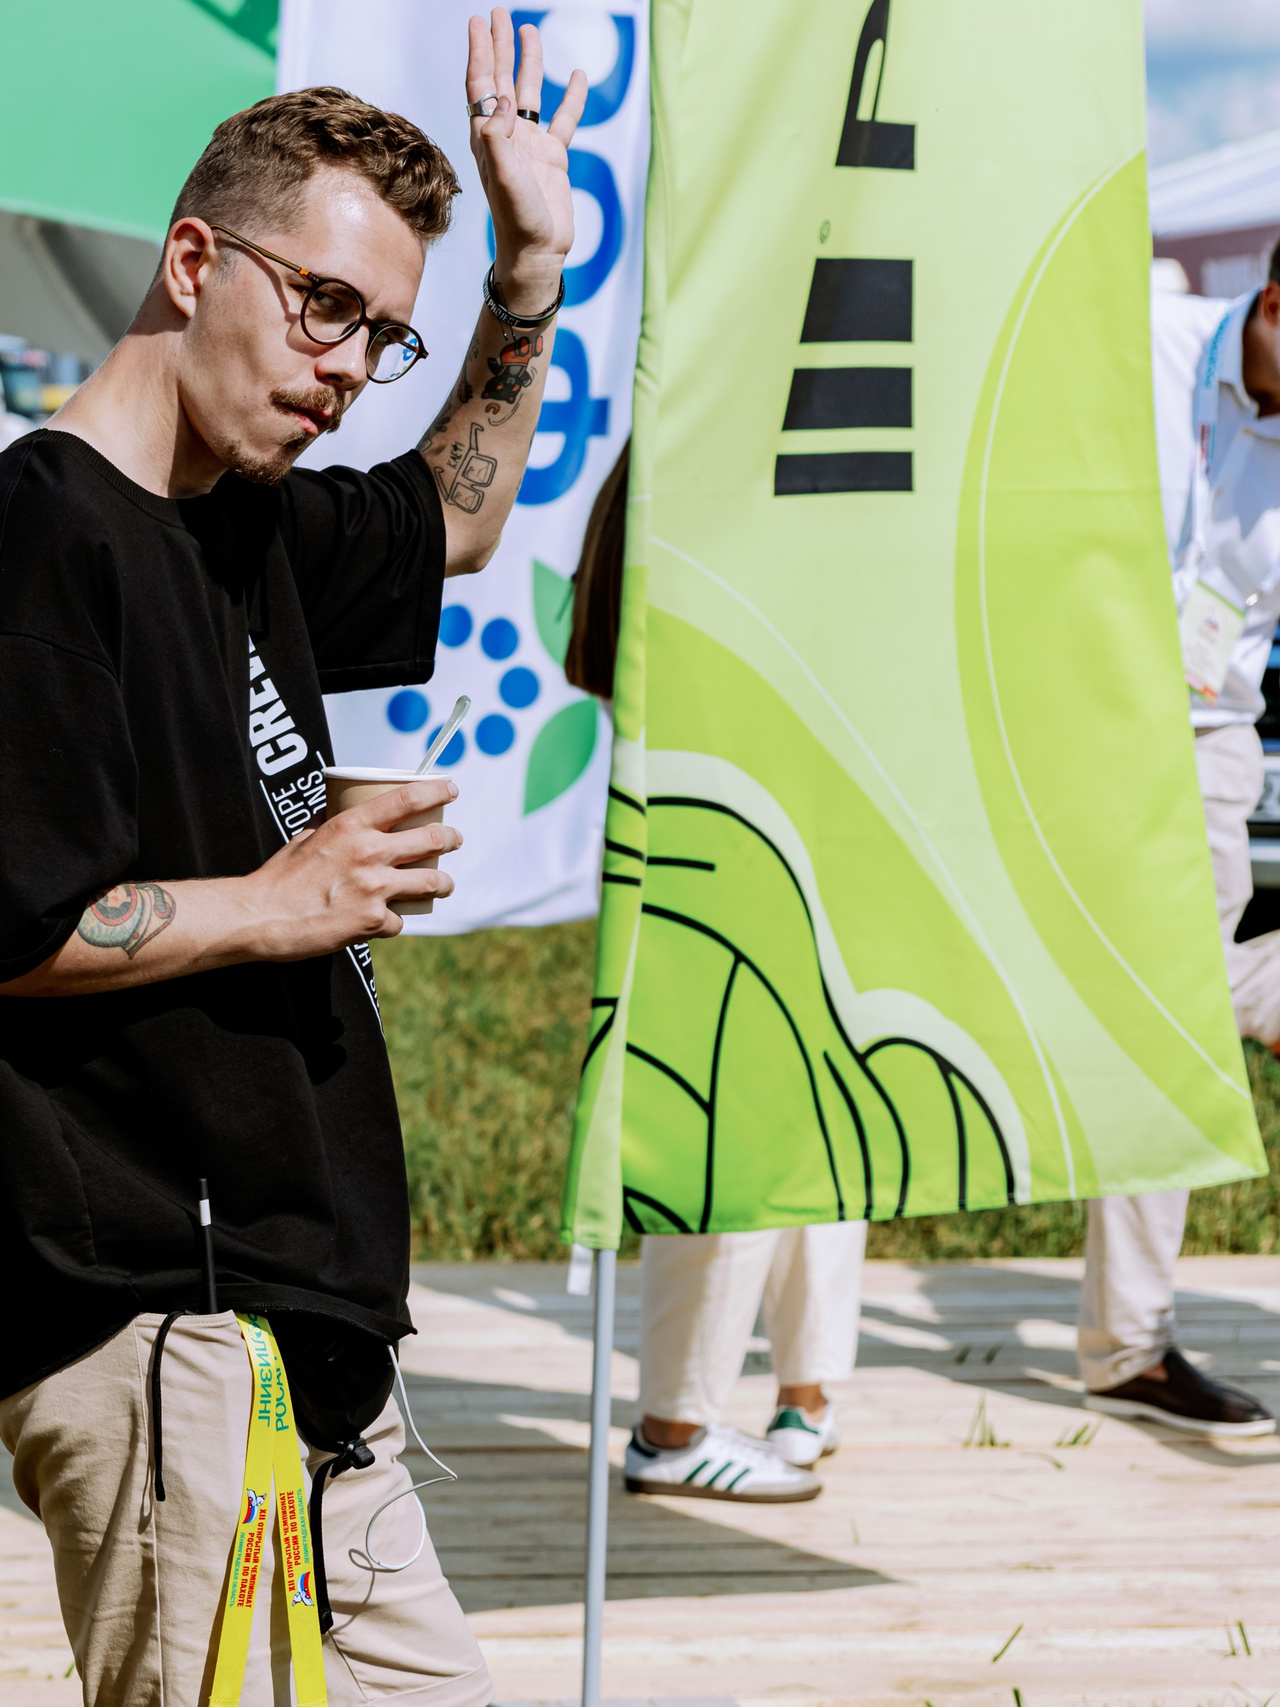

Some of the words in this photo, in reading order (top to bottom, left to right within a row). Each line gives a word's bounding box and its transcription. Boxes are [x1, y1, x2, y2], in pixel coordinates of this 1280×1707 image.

[279, 1492, 290, 1536] ЧЕМПИОНАТ
[287, 1490, 297, 1518] ПАХОТЕ
[289, 1521, 298, 1533] ПО
[244, 1532, 255, 1563] РОССИИ
[252, 1522, 265, 1564] ОТКРЫТЫЙ
[283, 1537, 294, 1578] ОТКРЫТЫЙ
[292, 1534, 302, 1566] РОССИИ
[242, 1566, 250, 1577] ПО
[245, 1565, 258, 1608] ЧЕМПИОНАТ
[237, 1579, 248, 1608] ПАХОТЕ
